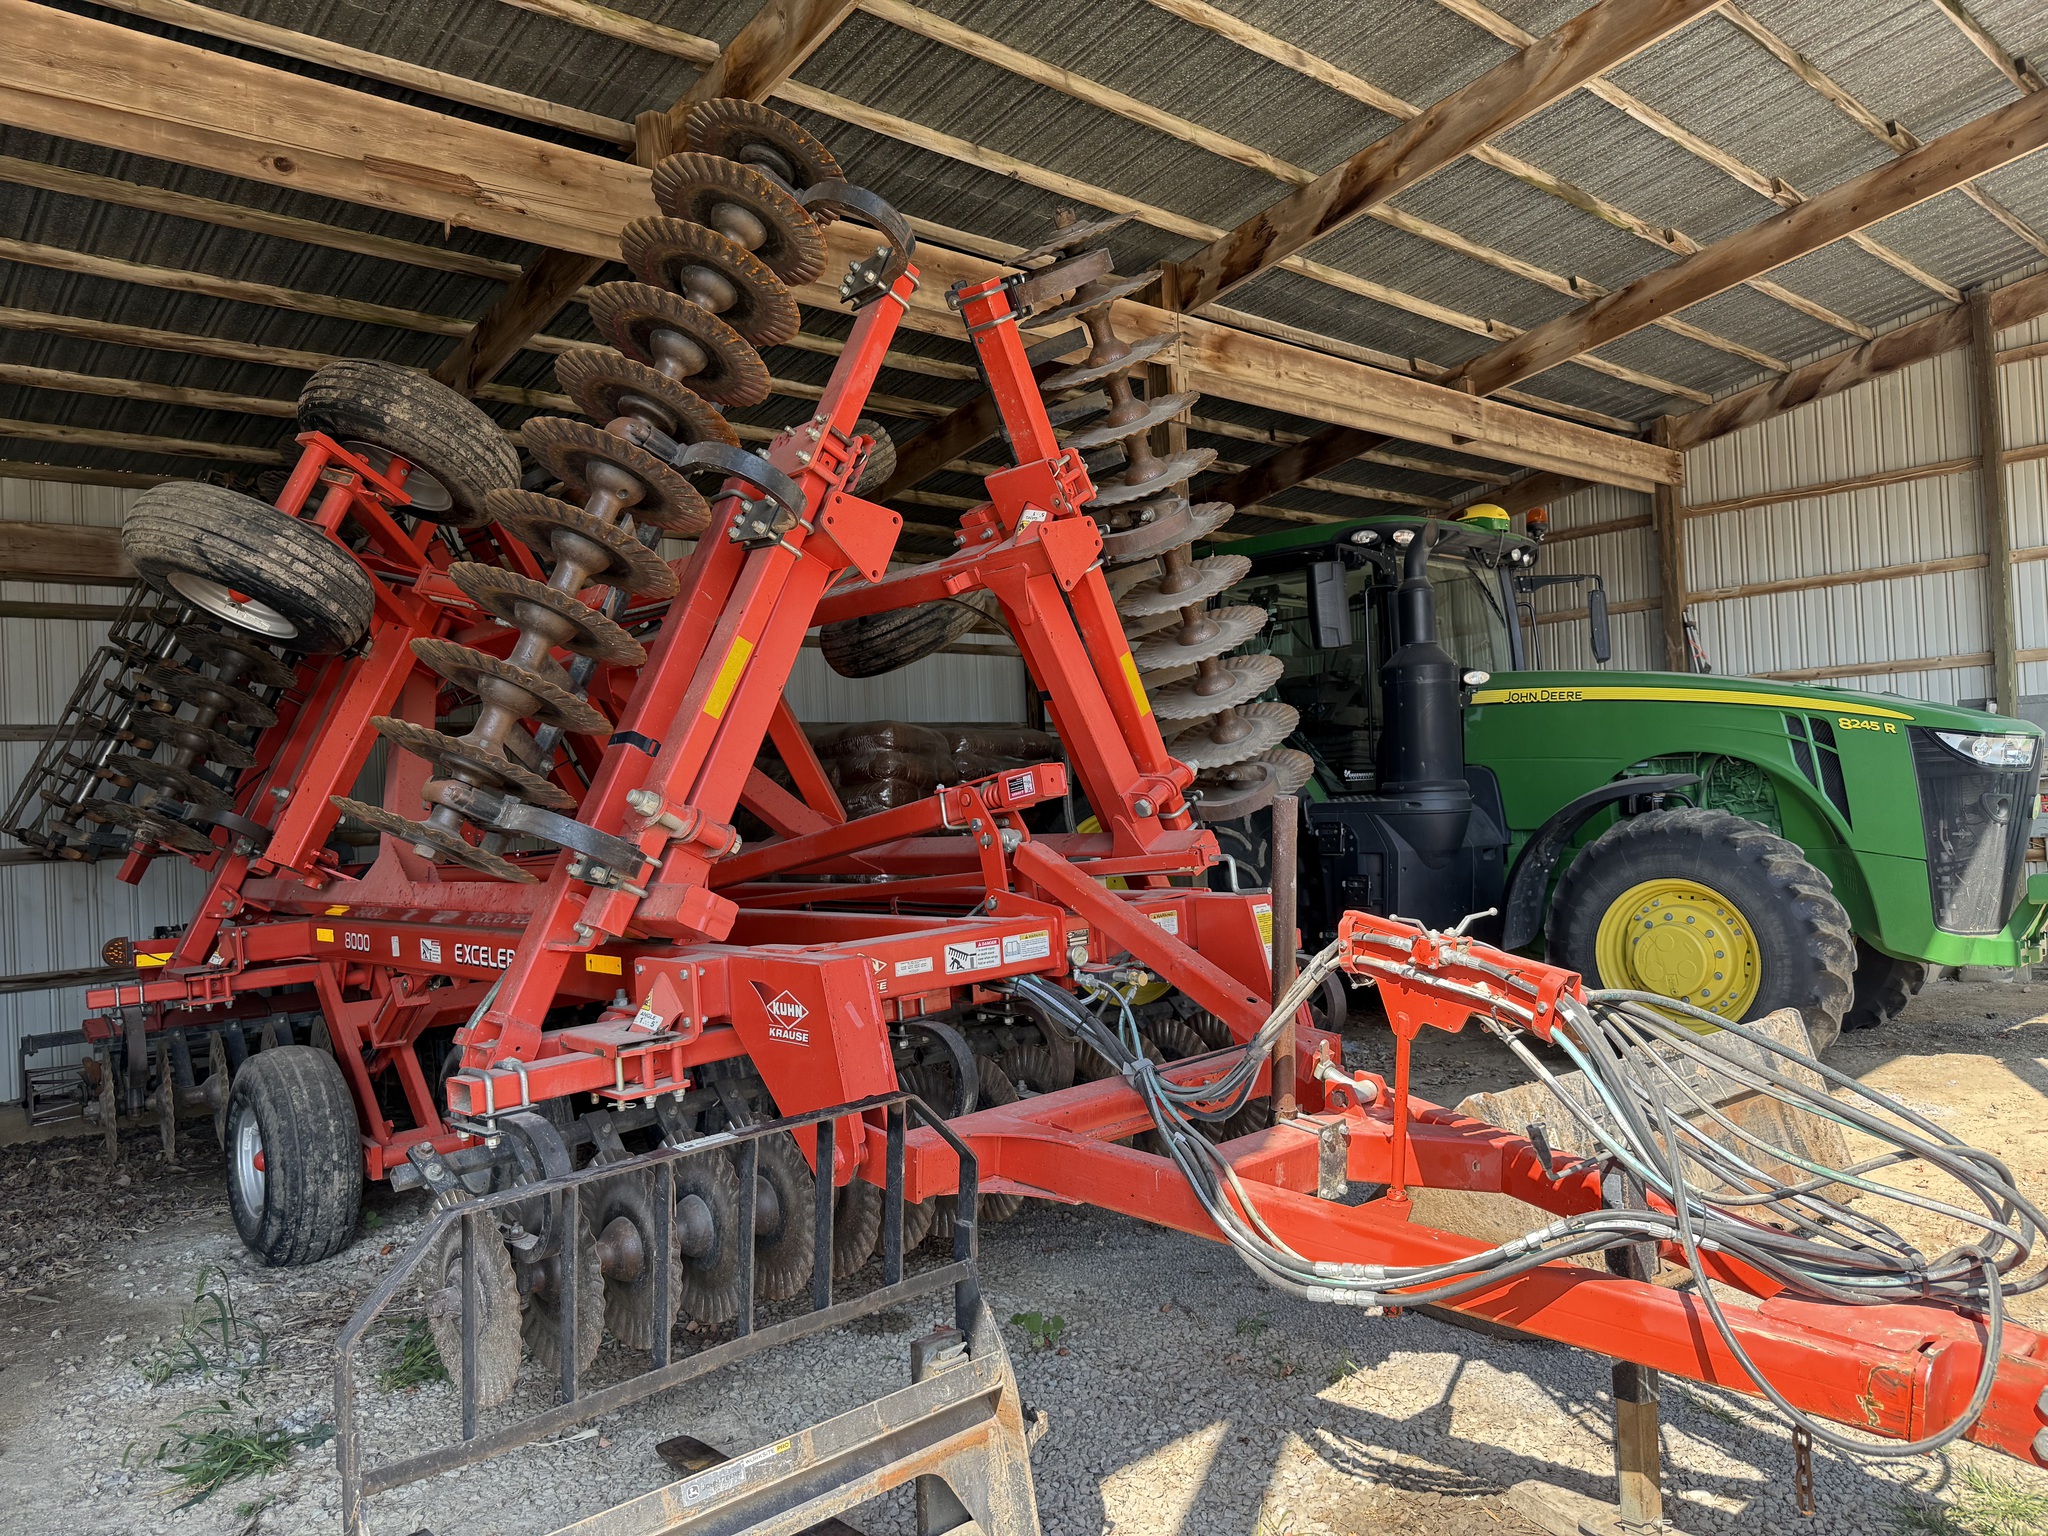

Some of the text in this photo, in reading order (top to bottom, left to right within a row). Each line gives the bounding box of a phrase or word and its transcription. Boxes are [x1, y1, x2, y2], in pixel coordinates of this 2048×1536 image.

[1504, 690, 1583, 702] JOHN DEERE
[1838, 717, 1897, 734] 8245 R
[344, 931, 371, 952] 8000
[981, 939, 998, 947] DANGER
[640, 1011, 657, 1021] ANGLE
[771, 1001, 804, 1019] KUHN
[768, 1027, 810, 1043] KRAUSE
[776, 1442, 790, 1452] PRO
